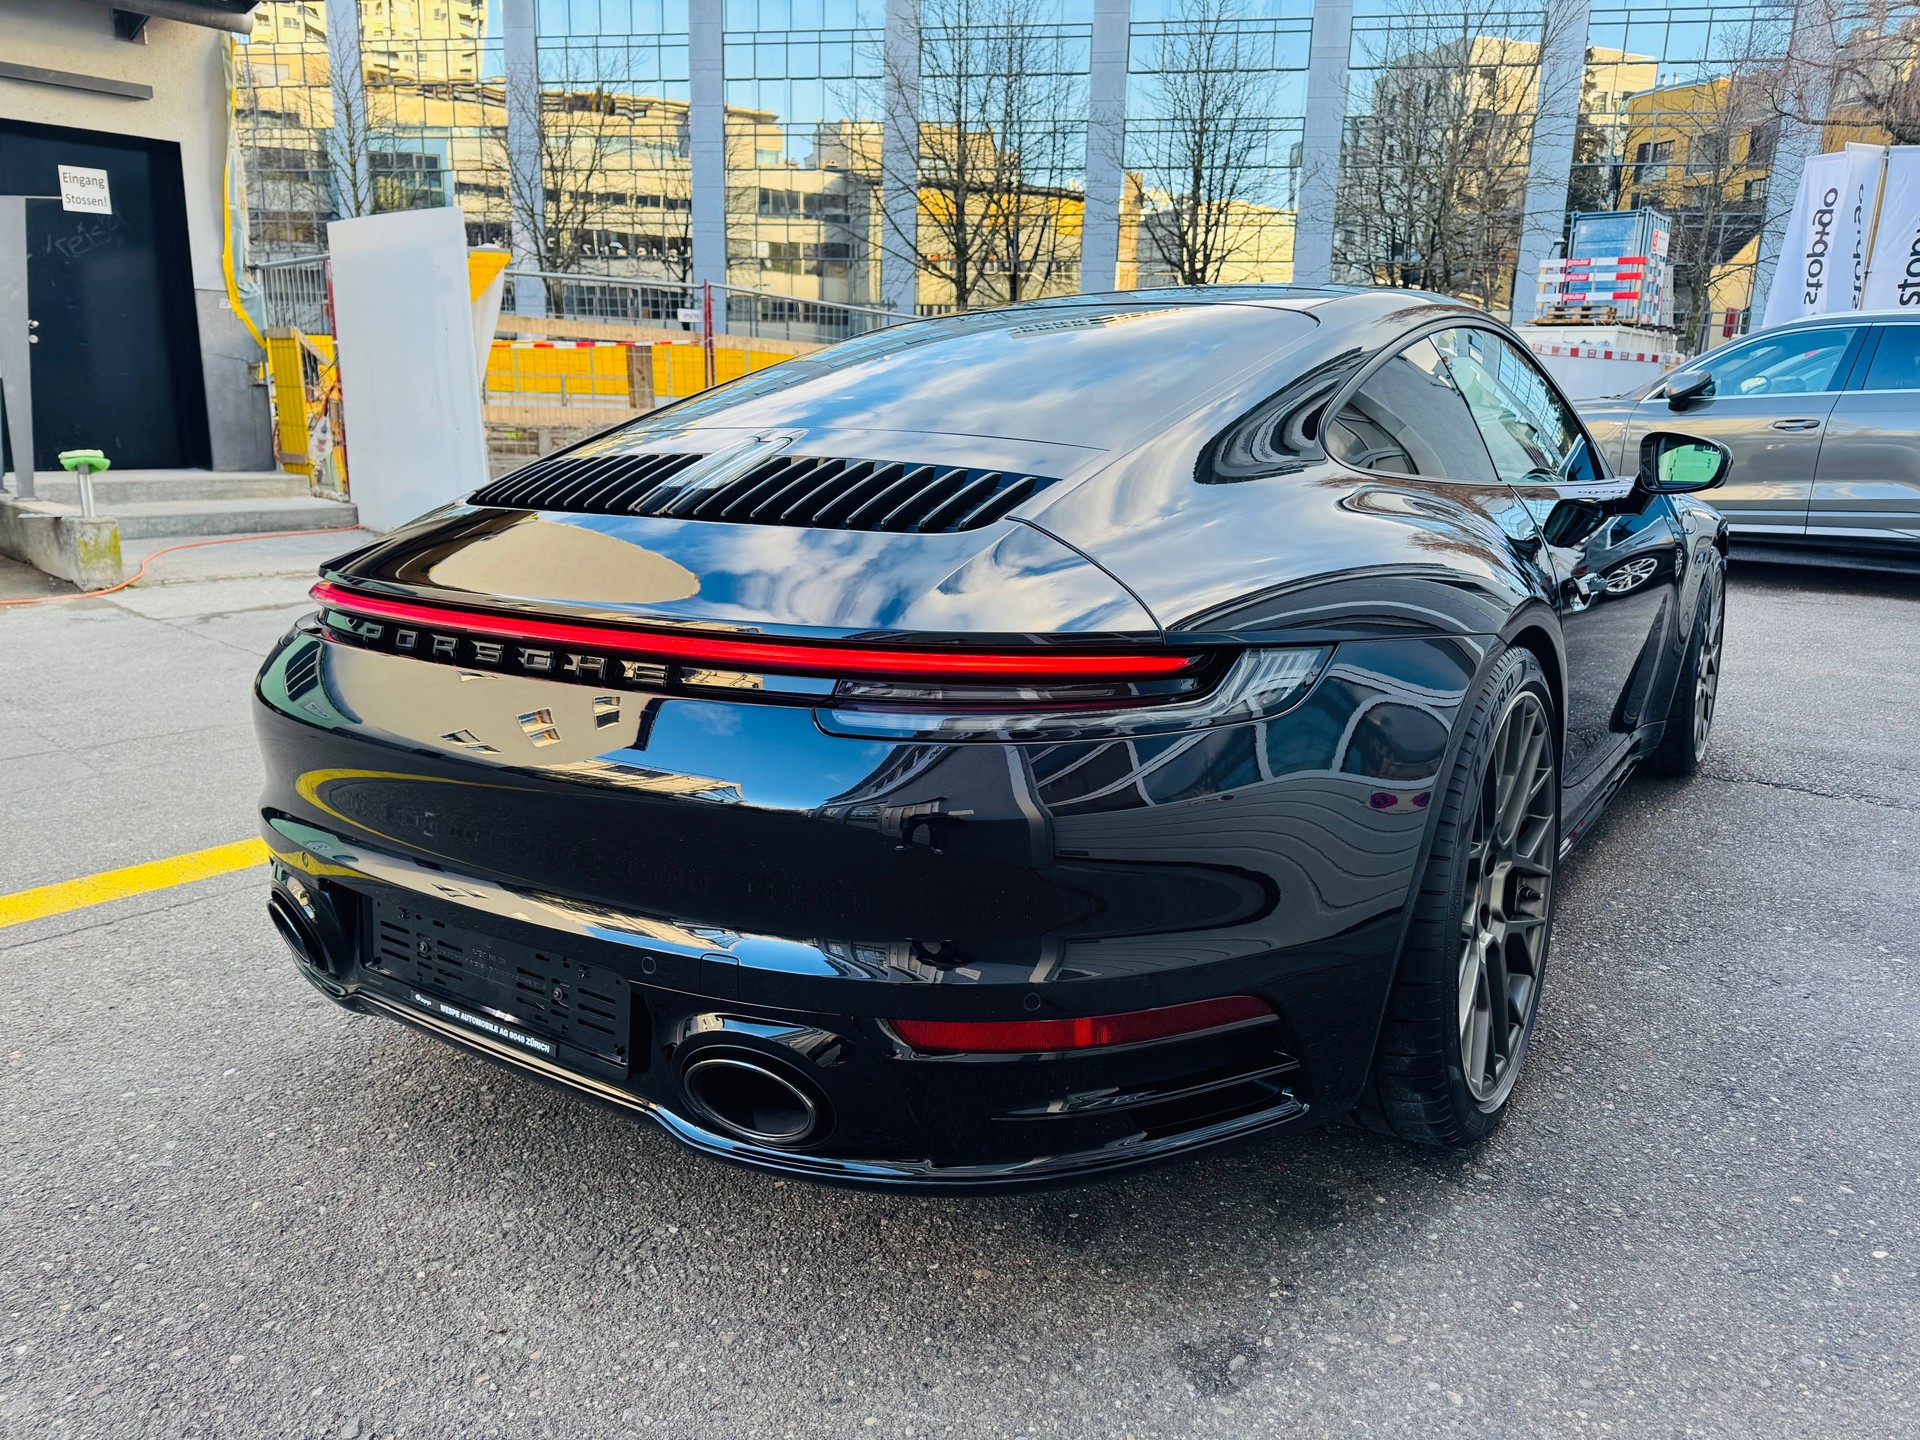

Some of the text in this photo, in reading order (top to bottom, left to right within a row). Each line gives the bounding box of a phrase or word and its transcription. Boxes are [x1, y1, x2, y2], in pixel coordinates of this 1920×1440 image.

[62, 172, 105, 190] Eingang
[65, 193, 108, 208] Stossen!
[362, 622, 669, 688] PORSCHE
[440, 1003, 460, 1018] WESPE
[460, 1012, 498, 1033] AUTOMOBILE
[500, 1027, 509, 1038] AG
[526, 1037, 550, 1054] ZÜRICH
